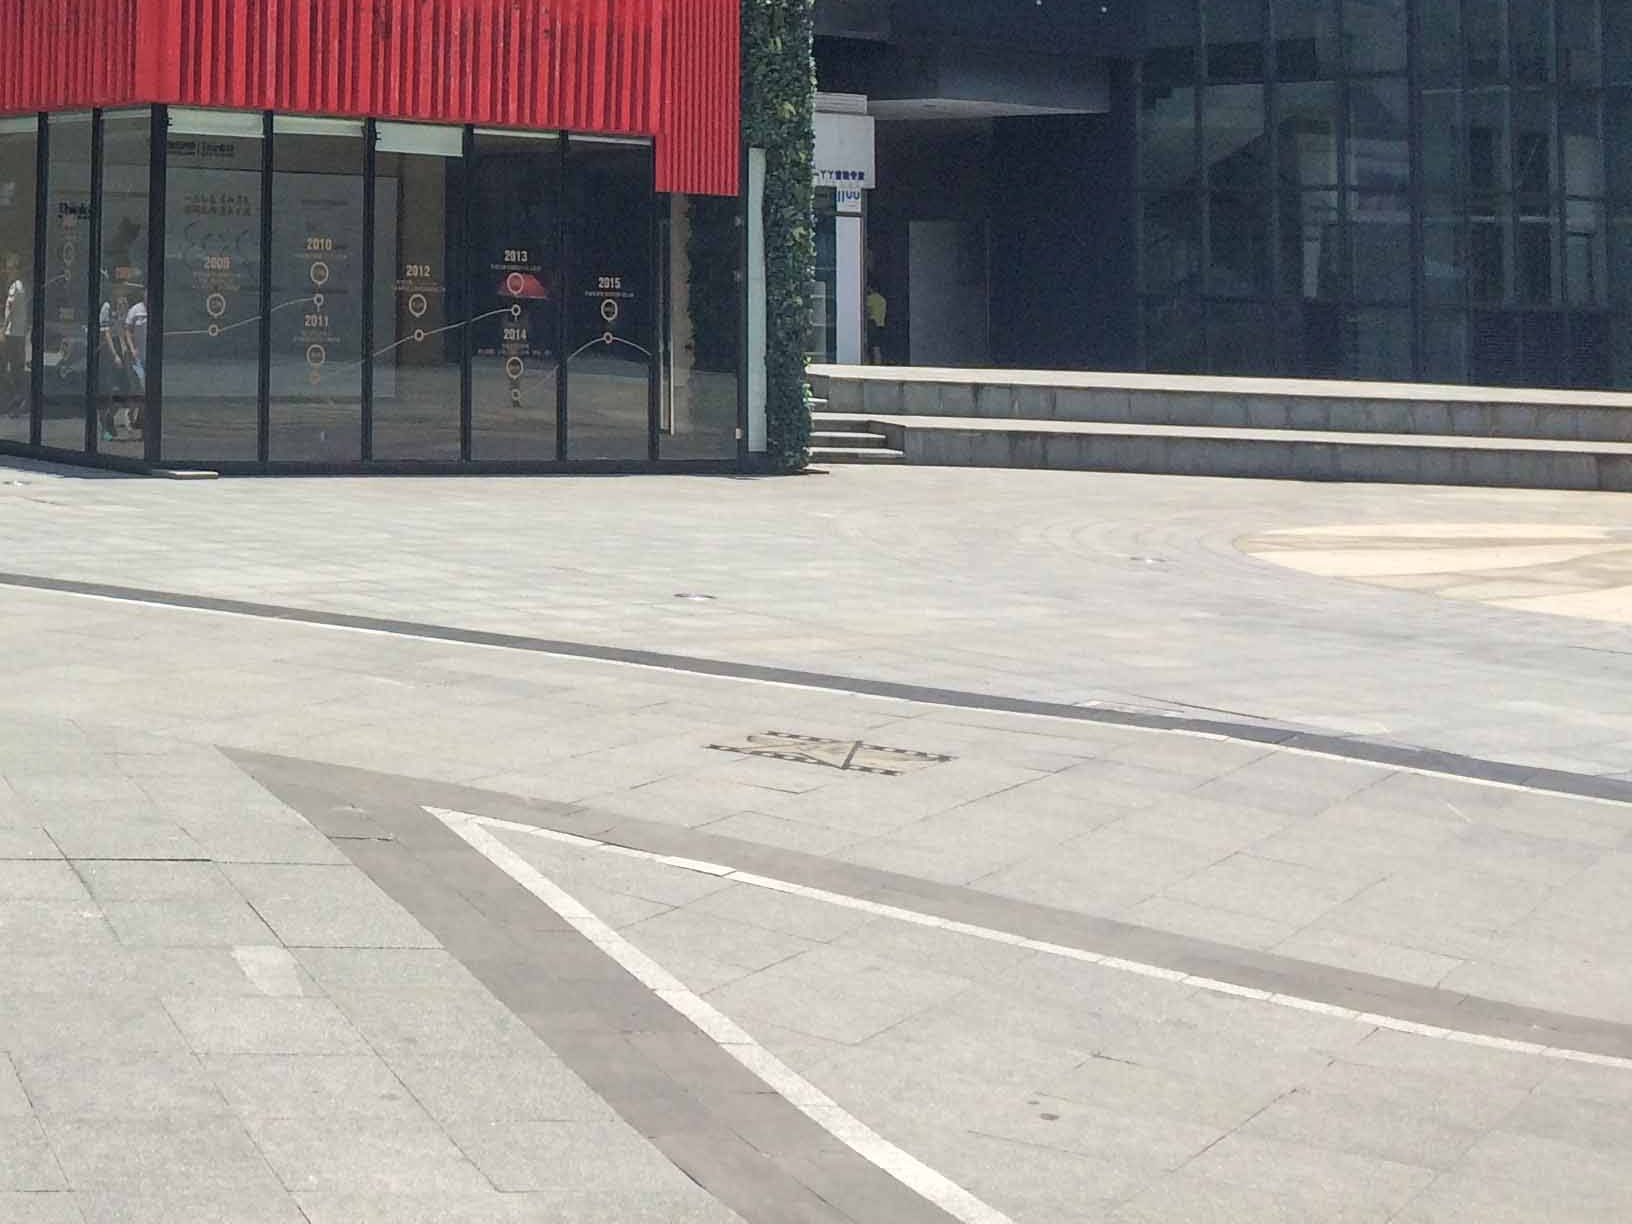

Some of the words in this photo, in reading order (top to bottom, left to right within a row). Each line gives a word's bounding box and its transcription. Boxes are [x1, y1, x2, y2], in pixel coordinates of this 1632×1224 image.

[305, 237, 333, 250] 2010
[503, 249, 528, 262] 2013
[405, 264, 431, 277] 2012
[597, 276, 621, 289] 2015
[304, 314, 330, 327] 2011
[503, 328, 528, 341] 2014
